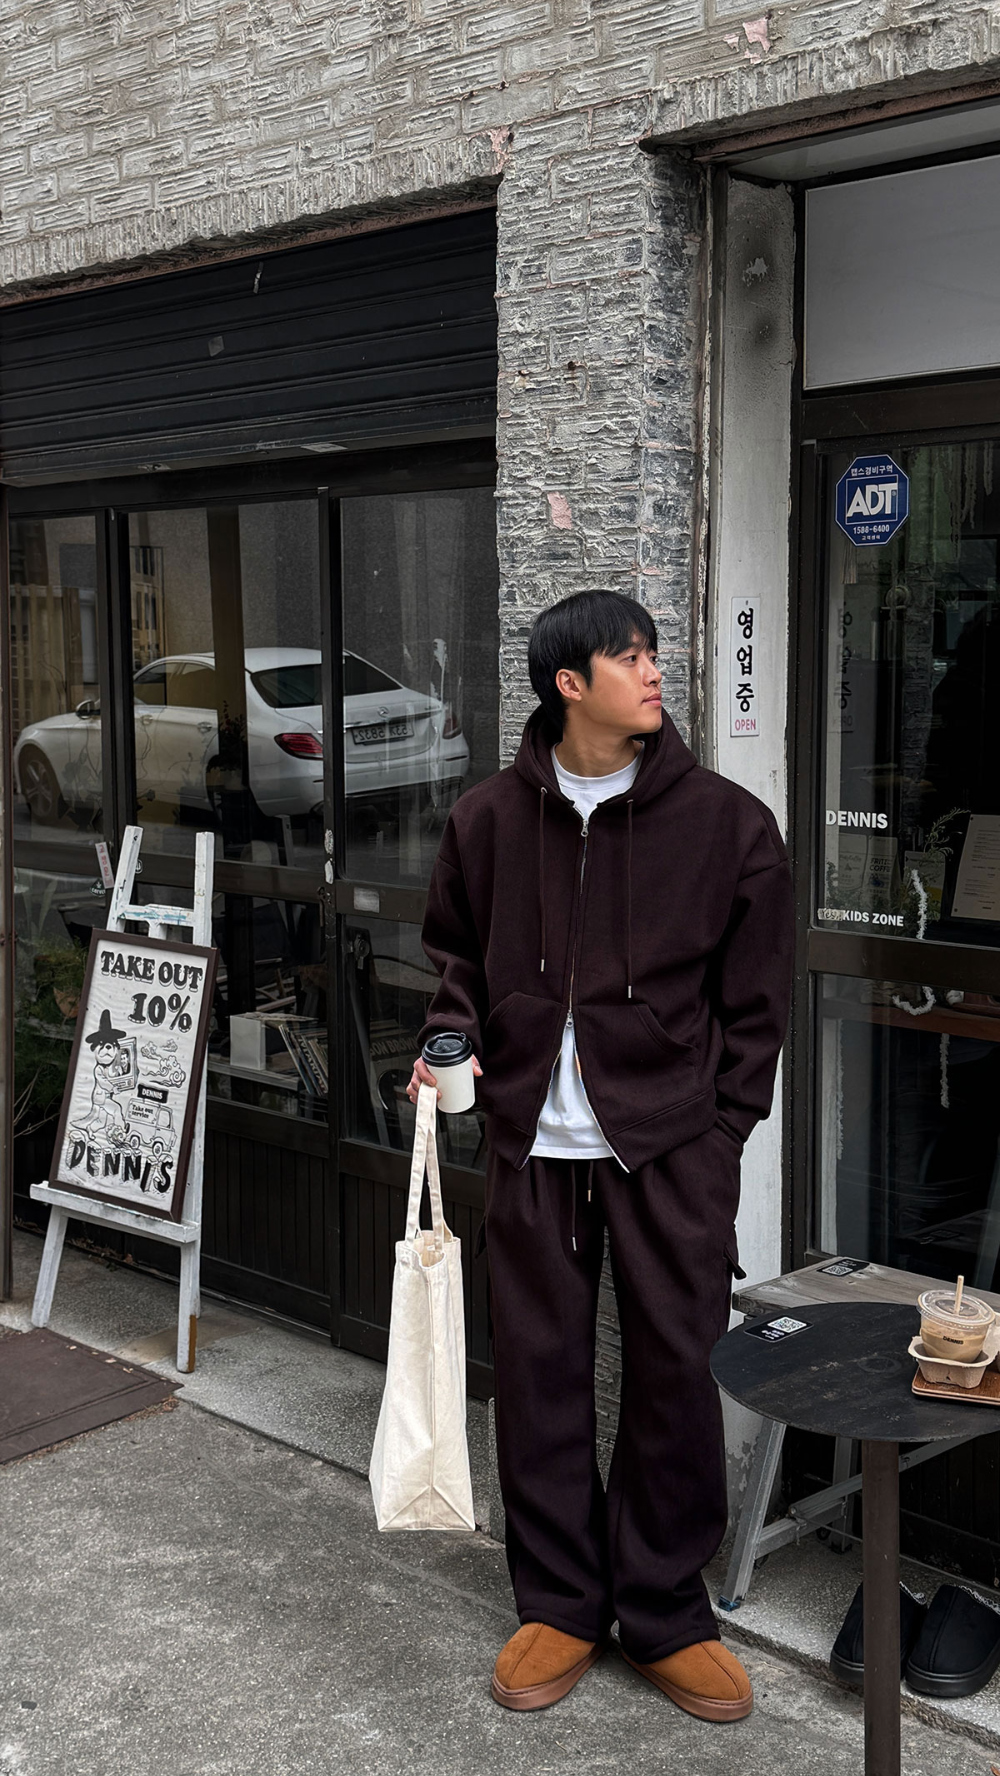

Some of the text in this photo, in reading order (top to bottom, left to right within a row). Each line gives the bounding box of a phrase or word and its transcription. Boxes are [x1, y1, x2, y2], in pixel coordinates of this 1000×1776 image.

[846, 483, 898, 517] ADT
[853, 525, 890, 534] 1588-6400
[736, 608, 754, 712] 영업중
[735, 719, 756, 731] OPEN
[826, 810, 888, 829] DENNIS
[842, 910, 904, 927] KIDS ZONE
[101, 950, 203, 993] TAKE OUT
[128, 993, 192, 1033] 10%
[141, 1088, 163, 1100] DENNIS
[66, 1131, 174, 1193] DENNIS
